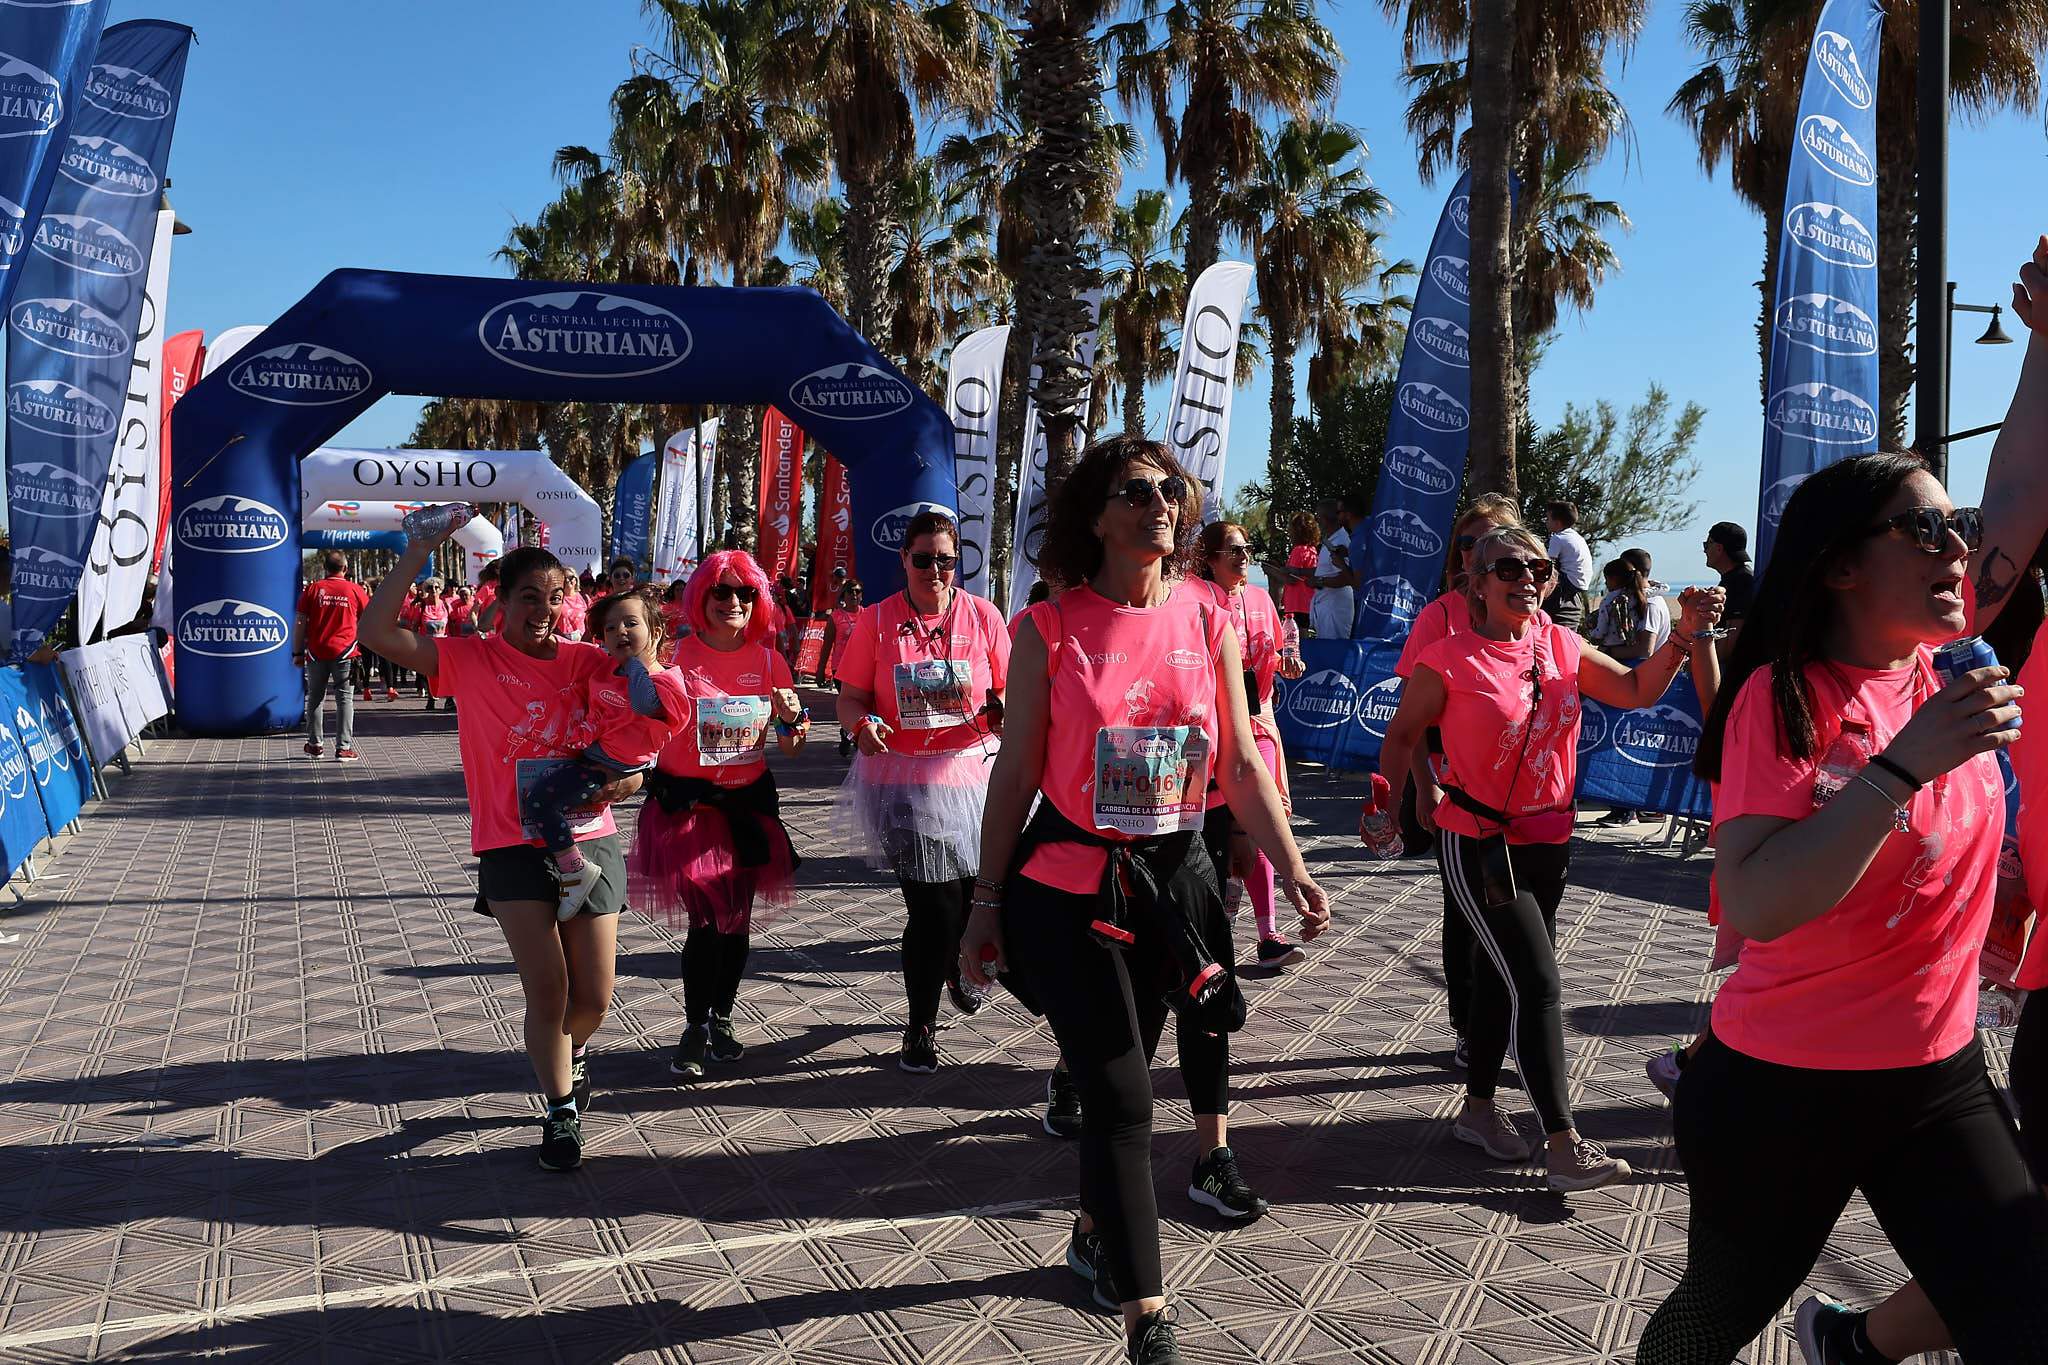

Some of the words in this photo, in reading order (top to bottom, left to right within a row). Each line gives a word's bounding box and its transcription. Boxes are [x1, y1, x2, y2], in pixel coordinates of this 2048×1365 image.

[1819, 40, 1866, 104] ASTURIANA
[3, 83, 56, 99] LECHERA
[85, 71, 165, 114] ASTURANA
[1805, 124, 1869, 181] ASTURIANA
[33, 222, 135, 272] ASTURIANA
[1793, 213, 1872, 262] ASTURIANA
[1434, 262, 1469, 297] ASTURI
[18, 307, 121, 353] ASTURIANA
[529, 313, 598, 327] CENTRAL
[603, 317, 670, 329] LECHERA
[1781, 307, 1873, 349] ASTURIANA
[496, 313, 679, 357] ASTURIANA
[237, 364, 361, 391] ASTURIANA
[261, 362, 308, 371] CENTRAL
[800, 384, 907, 406] ASTURIANA
[1402, 388, 1462, 427] ASTURIANA
[9, 391, 106, 432] ASTURIANA
[1773, 399, 1872, 435] ASTURIANA
[353, 458, 498, 488] OYSHO
[776, 420, 793, 512] Santander
[1390, 452, 1447, 490] ASTURIANA
[536, 490, 578, 501] OYSHO
[182, 516, 282, 541] ASTURIANA
[195, 514, 234, 522] CENTRAL
[238, 515, 278, 524] LECHERA
[624, 493, 646, 552] Marlene
[321, 529, 371, 546] Marlene
[558, 546, 597, 557] OYSHO
[775, 538, 789, 582] ports
[182, 620, 282, 642] ASTURIANA
[195, 618, 234, 626] CENTRAL
[237, 618, 278, 626] LECHERA
[1077, 652, 1128, 665] OYSHO
[1475, 670, 1512, 682] OSHO
[1291, 688, 1351, 716] ASTURIANA
[724, 726, 752, 739] 016
[1136, 774, 1174, 792] 016
[1101, 805, 1130, 814] CARRERA
[1145, 797, 1165, 806] 5776
[1107, 818, 1144, 828] OYSHO
